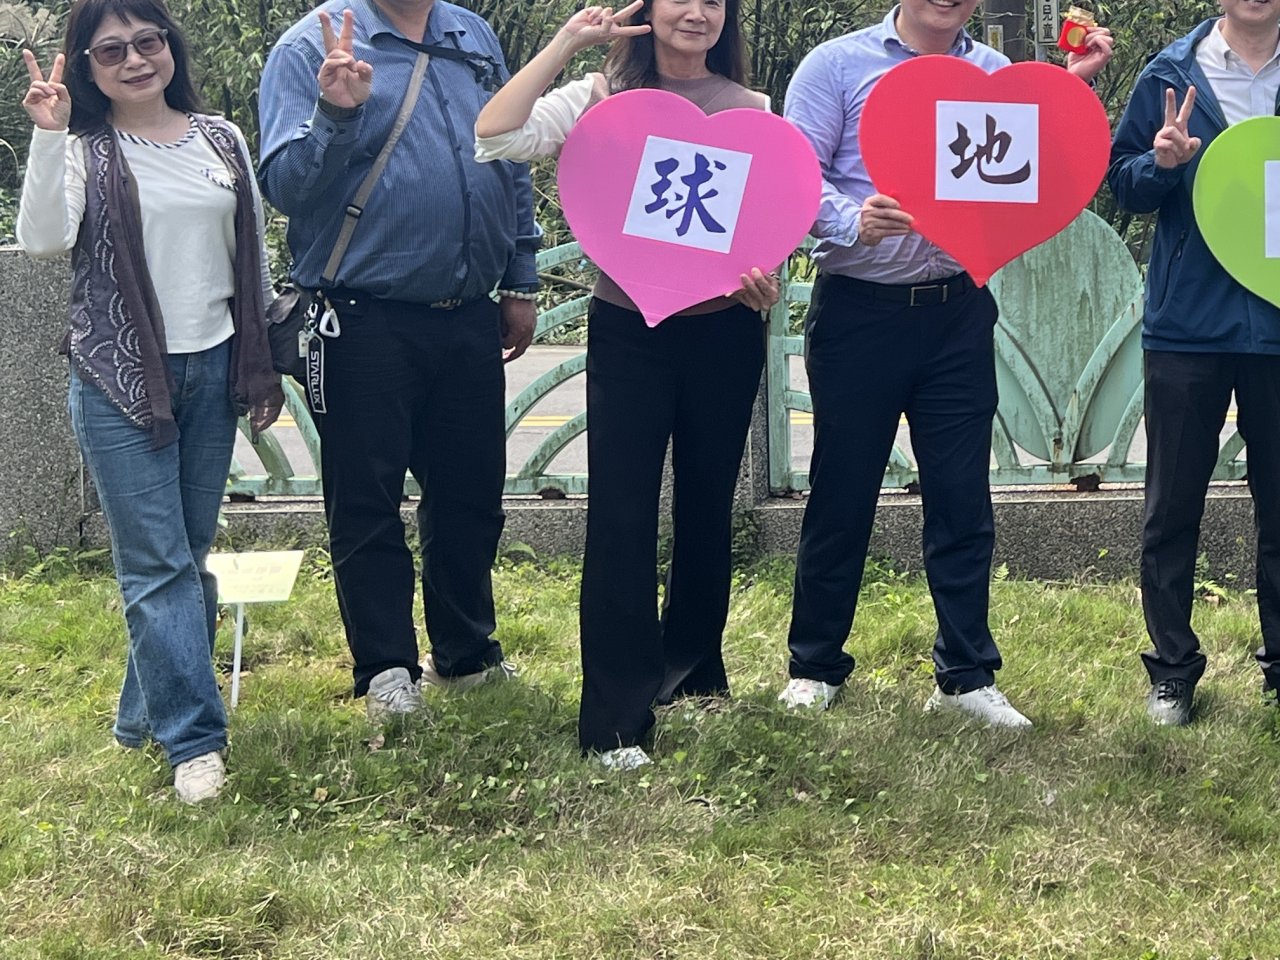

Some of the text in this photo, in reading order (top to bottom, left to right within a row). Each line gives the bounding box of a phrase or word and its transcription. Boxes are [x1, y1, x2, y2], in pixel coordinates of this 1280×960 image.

[948, 113, 1031, 185] 地
[645, 152, 727, 237] 球
[310, 350, 321, 404] STARLUX
